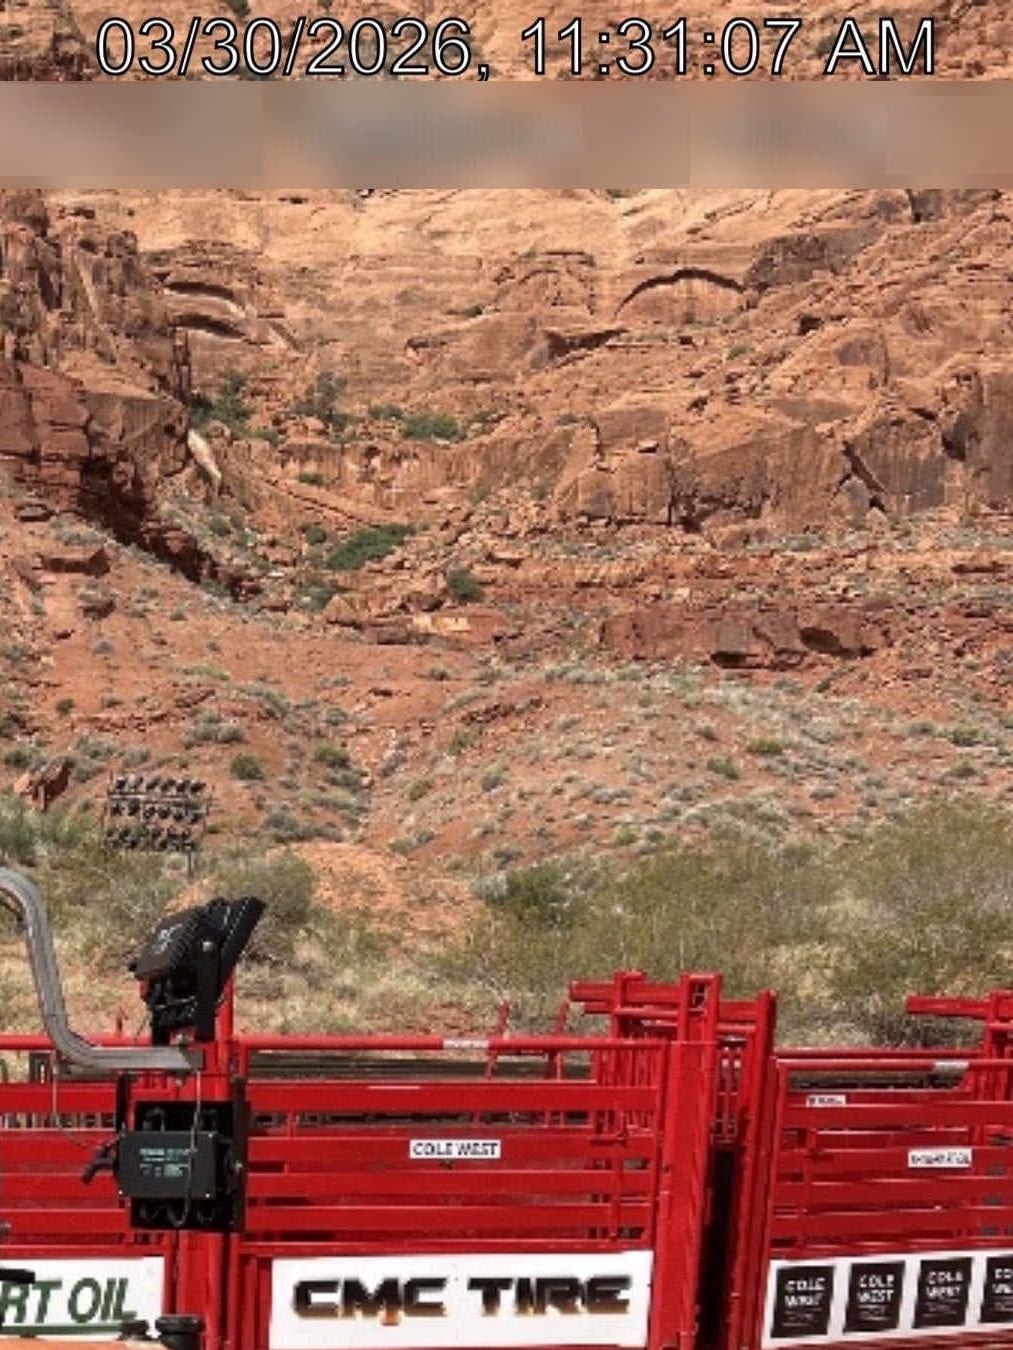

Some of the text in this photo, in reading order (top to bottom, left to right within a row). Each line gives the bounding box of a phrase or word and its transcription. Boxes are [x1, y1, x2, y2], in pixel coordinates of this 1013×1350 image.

[412, 1142, 498, 1156] COLE WEST
[68, 1277, 137, 1324] OIL
[292, 1275, 632, 1319] CMC TIRE
